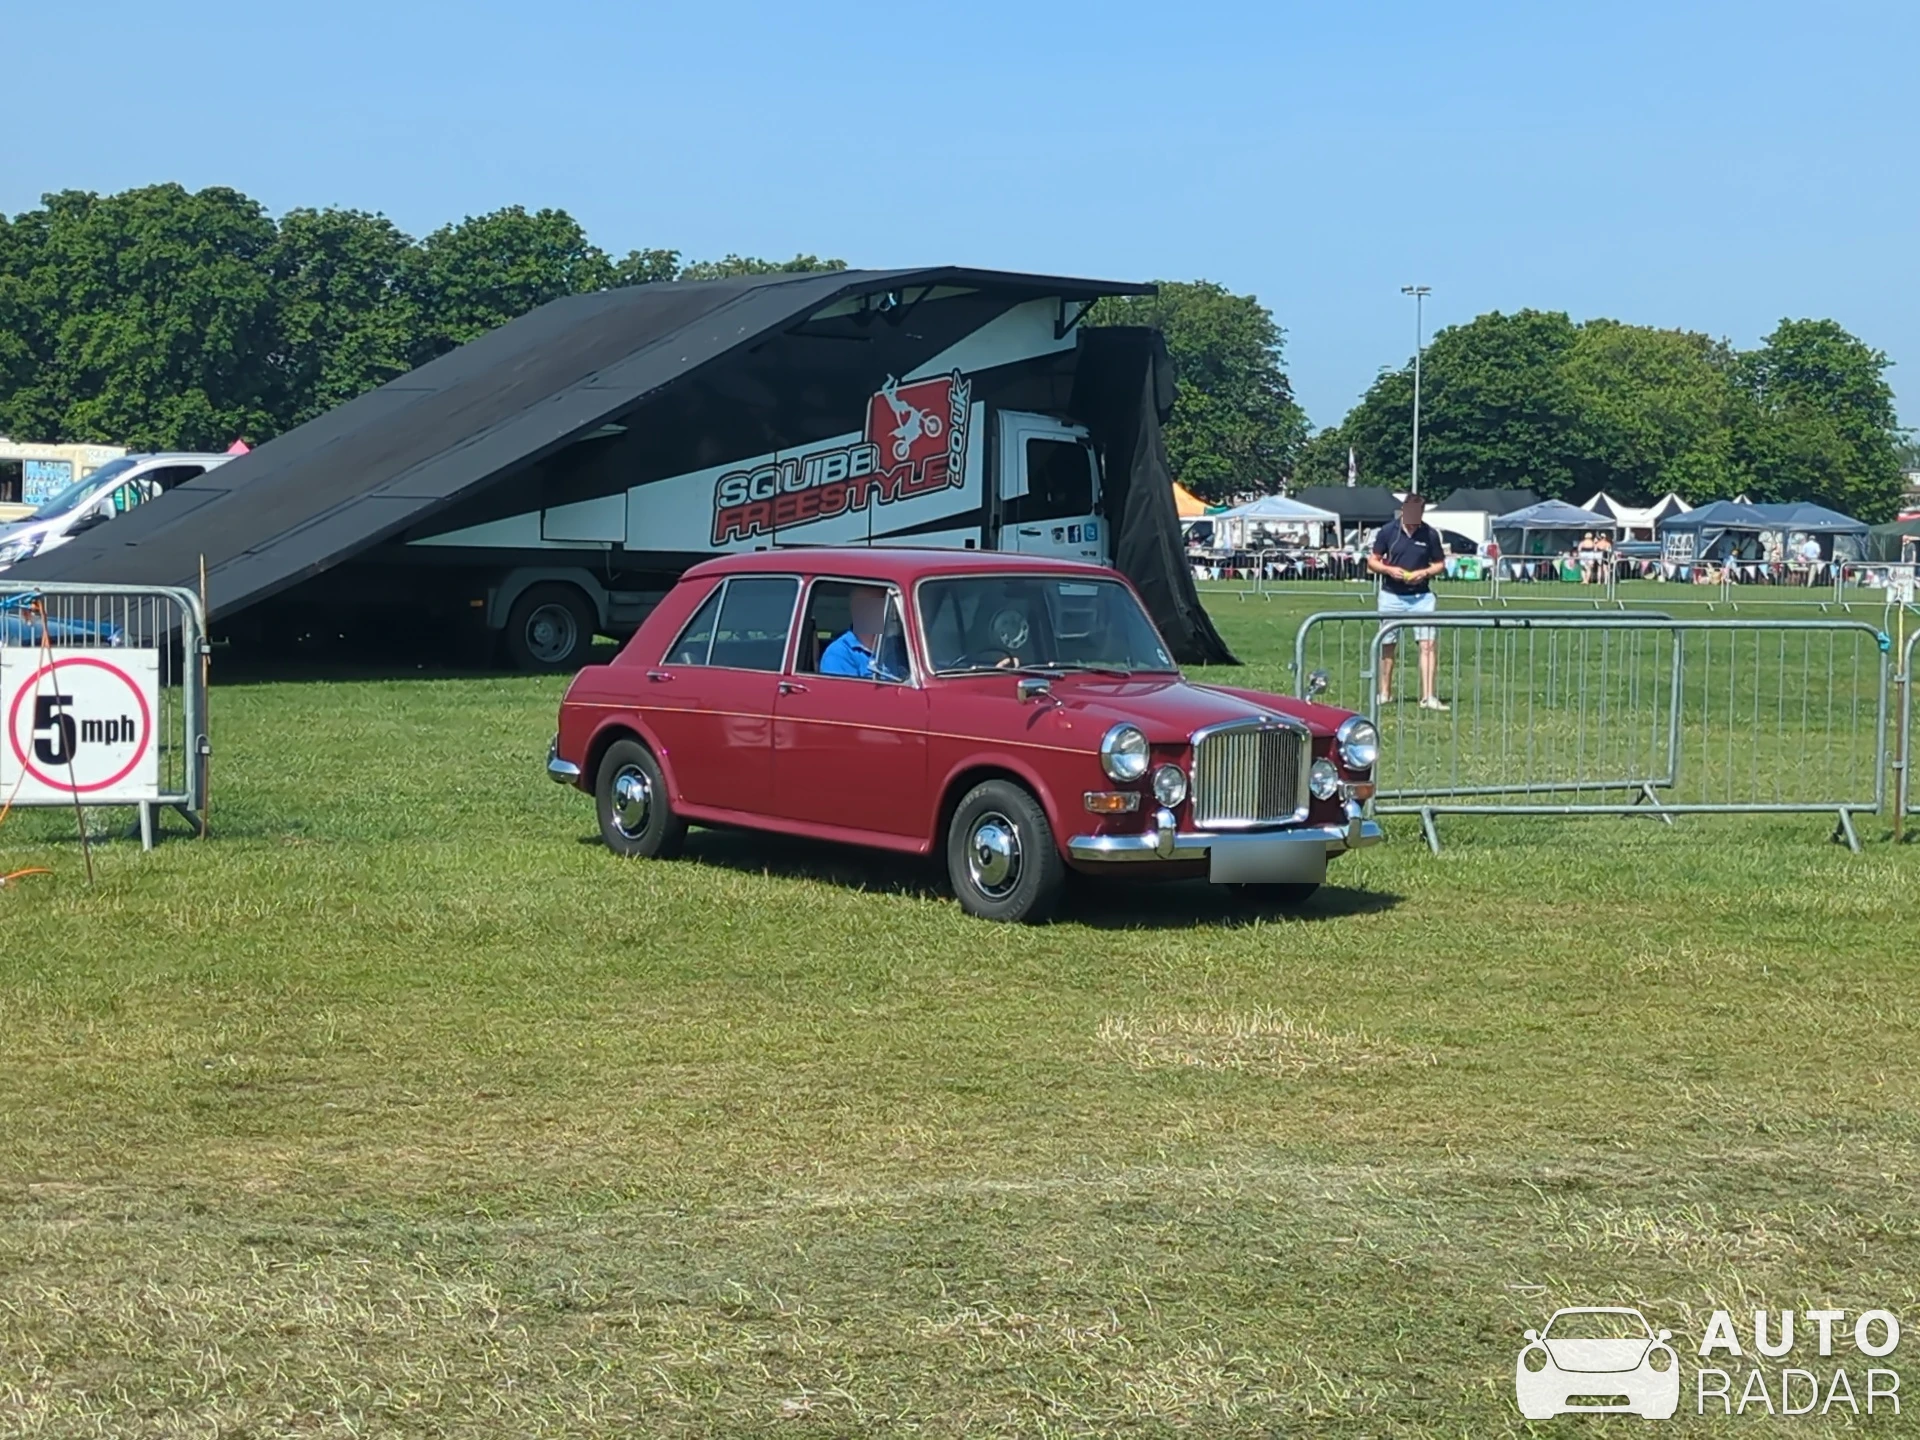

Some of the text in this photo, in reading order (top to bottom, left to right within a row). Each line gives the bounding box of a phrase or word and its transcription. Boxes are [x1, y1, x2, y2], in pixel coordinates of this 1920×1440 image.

[713, 457, 949, 543] FREESTYLE
[717, 446, 878, 508] SQUIBB
[34, 695, 135, 765] 5 mph
